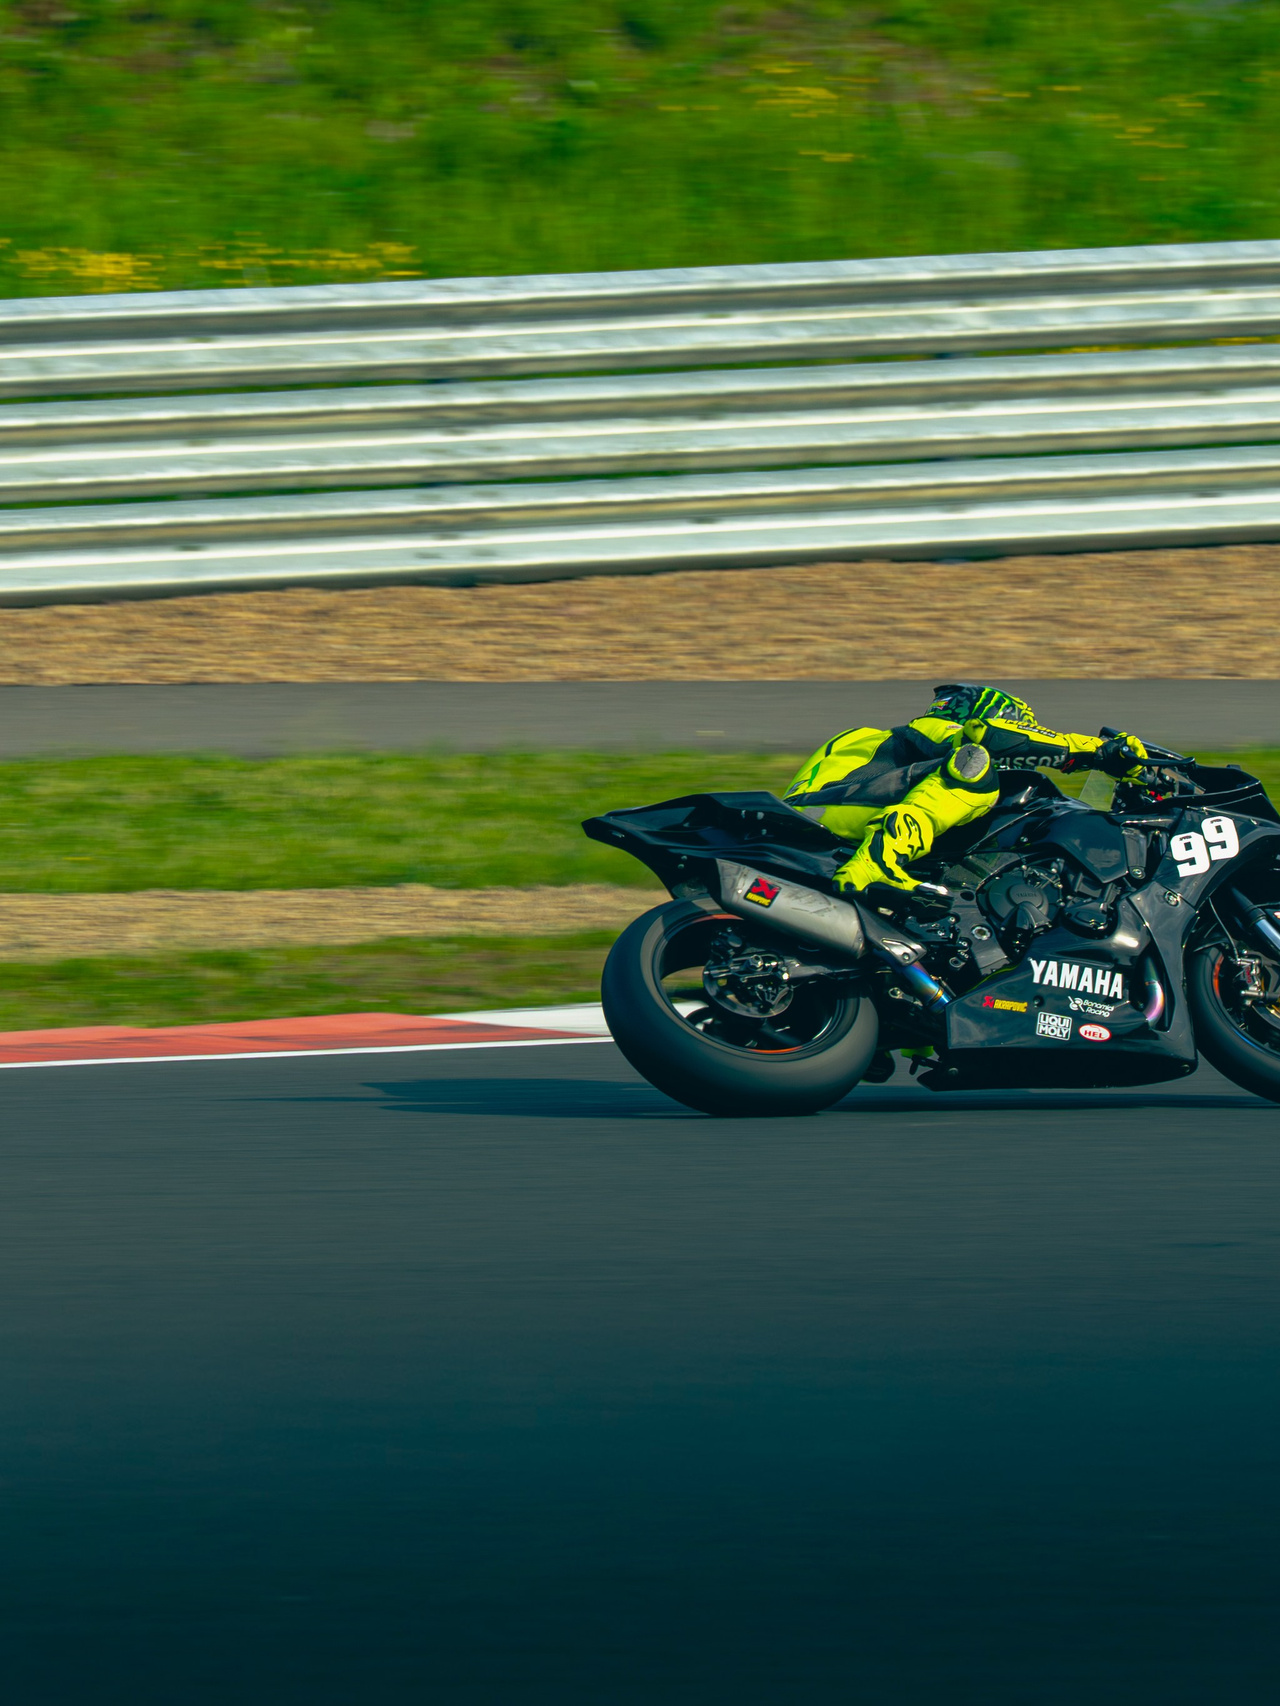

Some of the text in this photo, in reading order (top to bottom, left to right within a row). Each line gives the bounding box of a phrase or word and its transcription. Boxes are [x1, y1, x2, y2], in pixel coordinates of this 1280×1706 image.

[1170, 816, 1240, 878] 99
[1029, 959, 1123, 999] YAMAHA
[1040, 1014, 1070, 1028] LIQUI
[1039, 1024, 1069, 1038] MOLY
[1084, 1030, 1104, 1040] HEL
